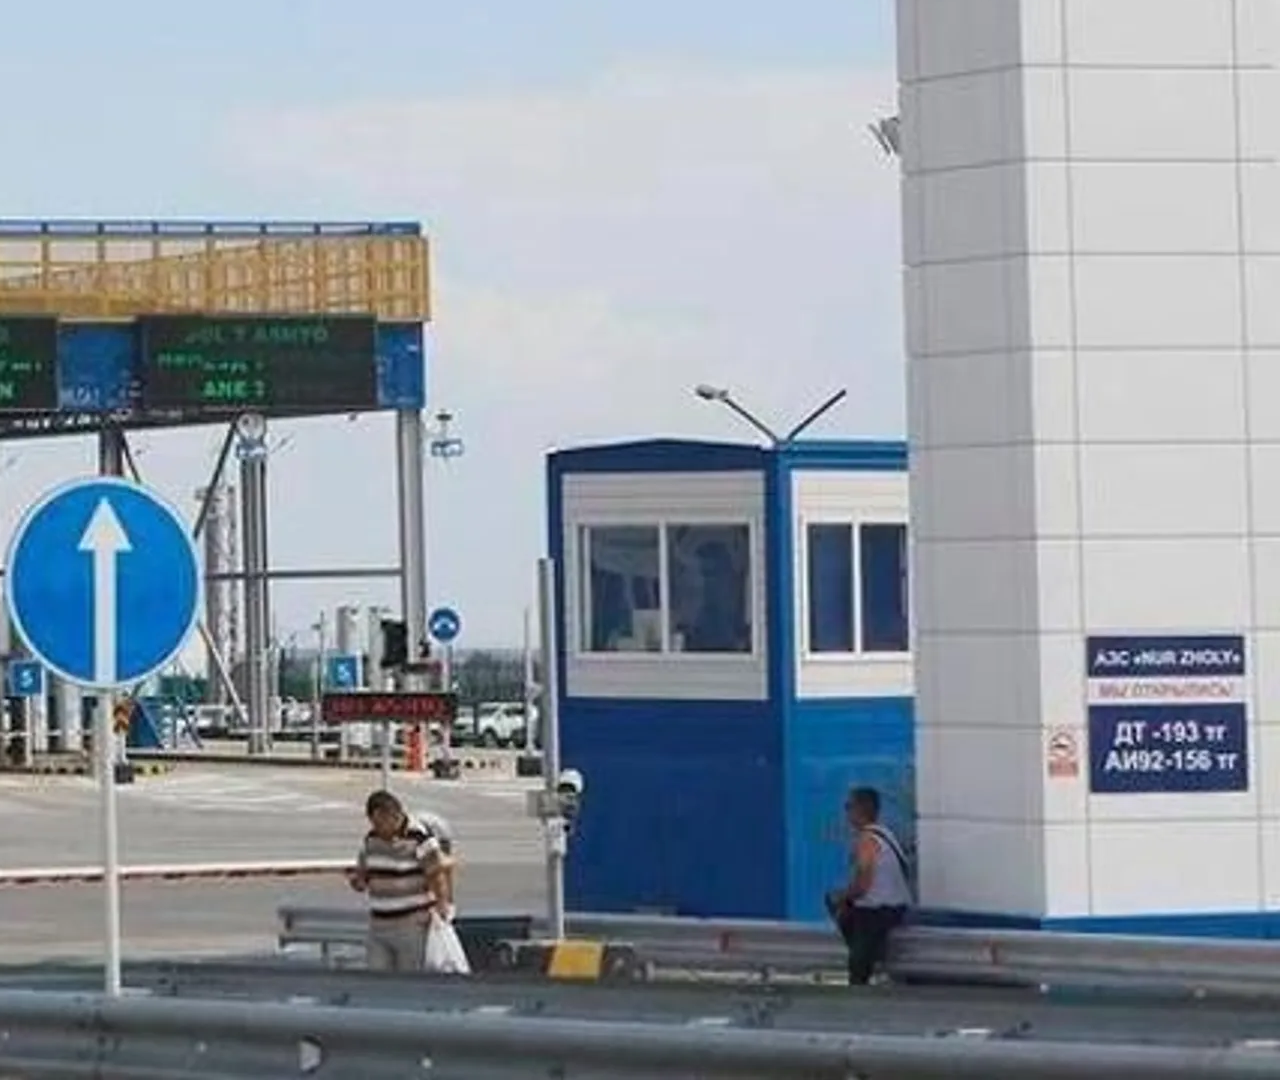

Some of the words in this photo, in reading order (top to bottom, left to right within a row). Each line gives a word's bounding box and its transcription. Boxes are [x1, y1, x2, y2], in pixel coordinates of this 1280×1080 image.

[1094, 649, 1130, 666] АЗС
[1114, 722, 1146, 747] ДТ
[1151, 721, 1201, 743] -193
[1204, 724, 1227, 742] тг
[1104, 750, 1213, 771] АИ92-156
[1217, 752, 1239, 771] тг
